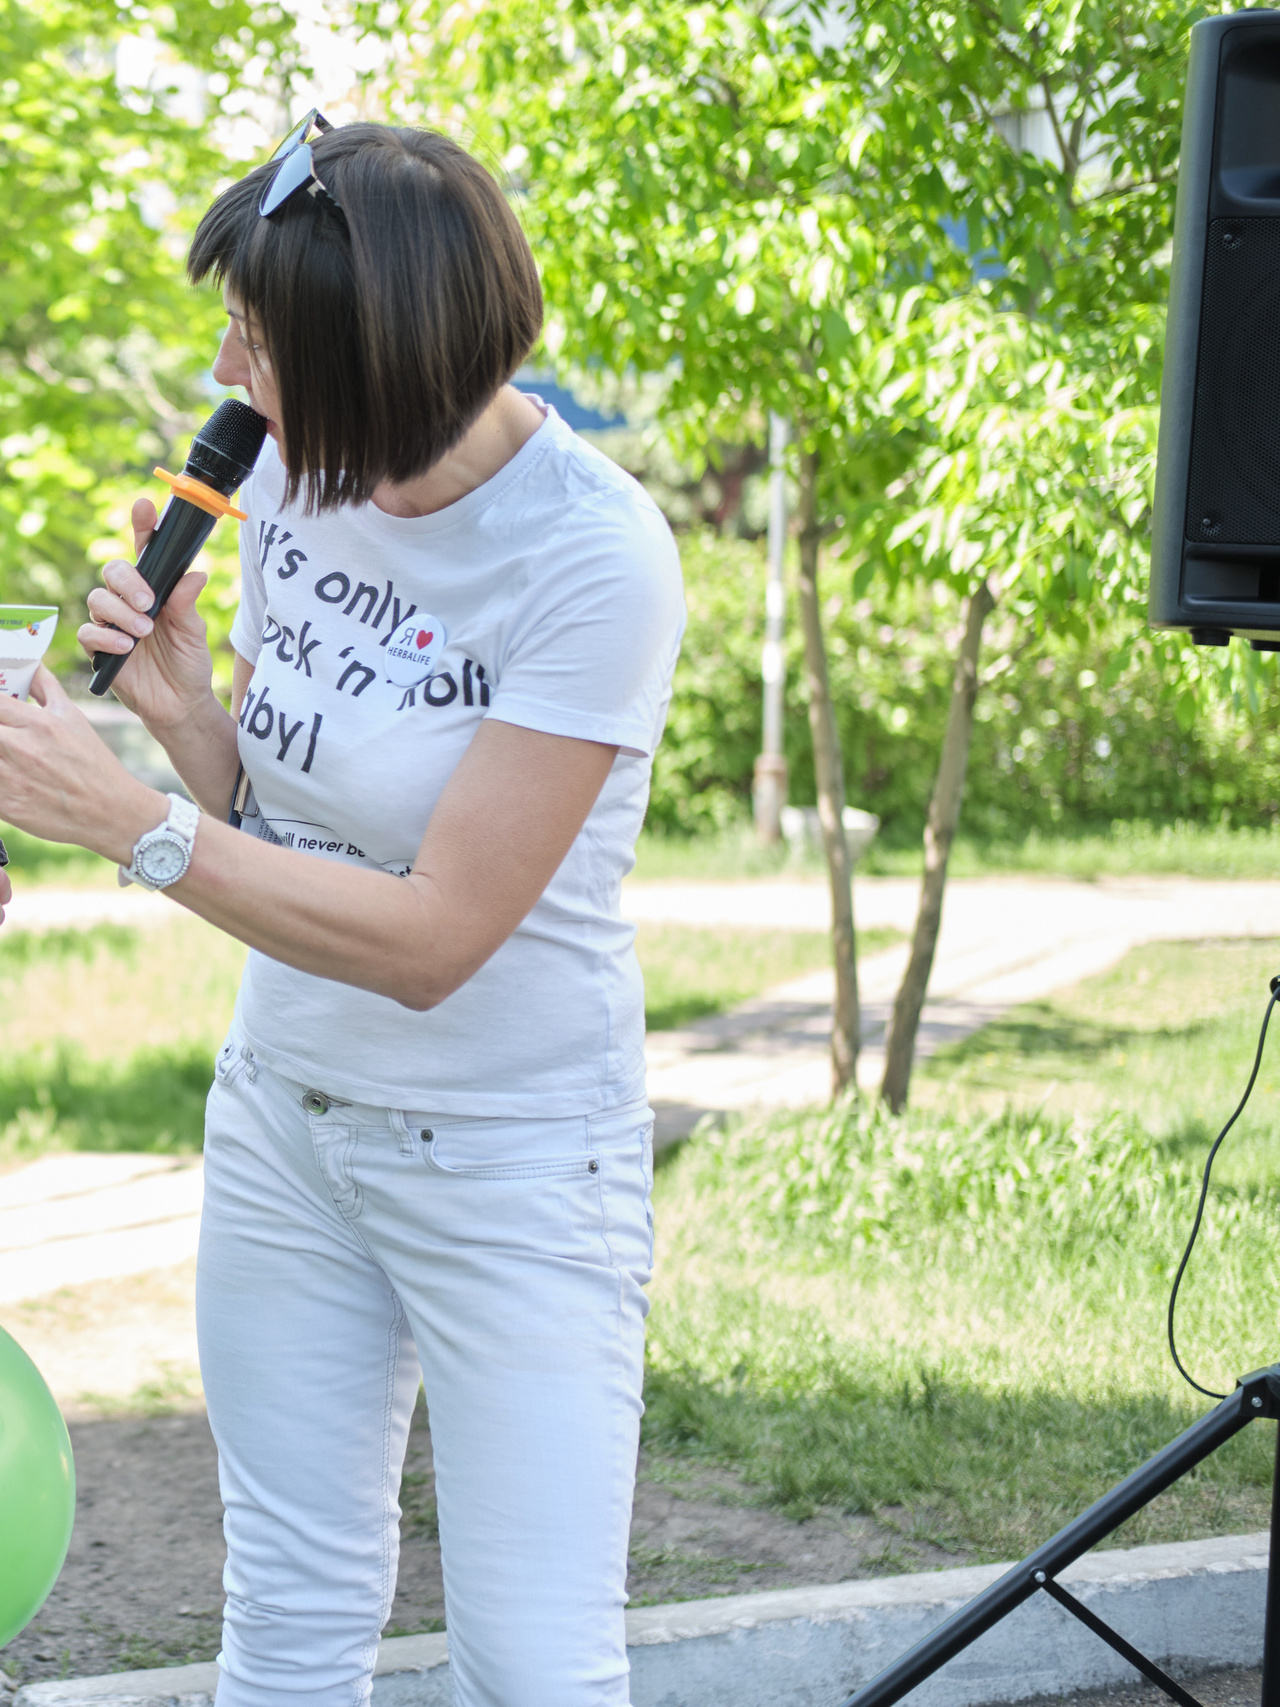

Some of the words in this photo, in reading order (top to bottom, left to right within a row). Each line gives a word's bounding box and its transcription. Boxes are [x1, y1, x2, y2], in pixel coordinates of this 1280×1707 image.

[262, 614, 323, 678] ock
[387, 646, 432, 666] HERBALIFE
[298, 838, 344, 853] never
